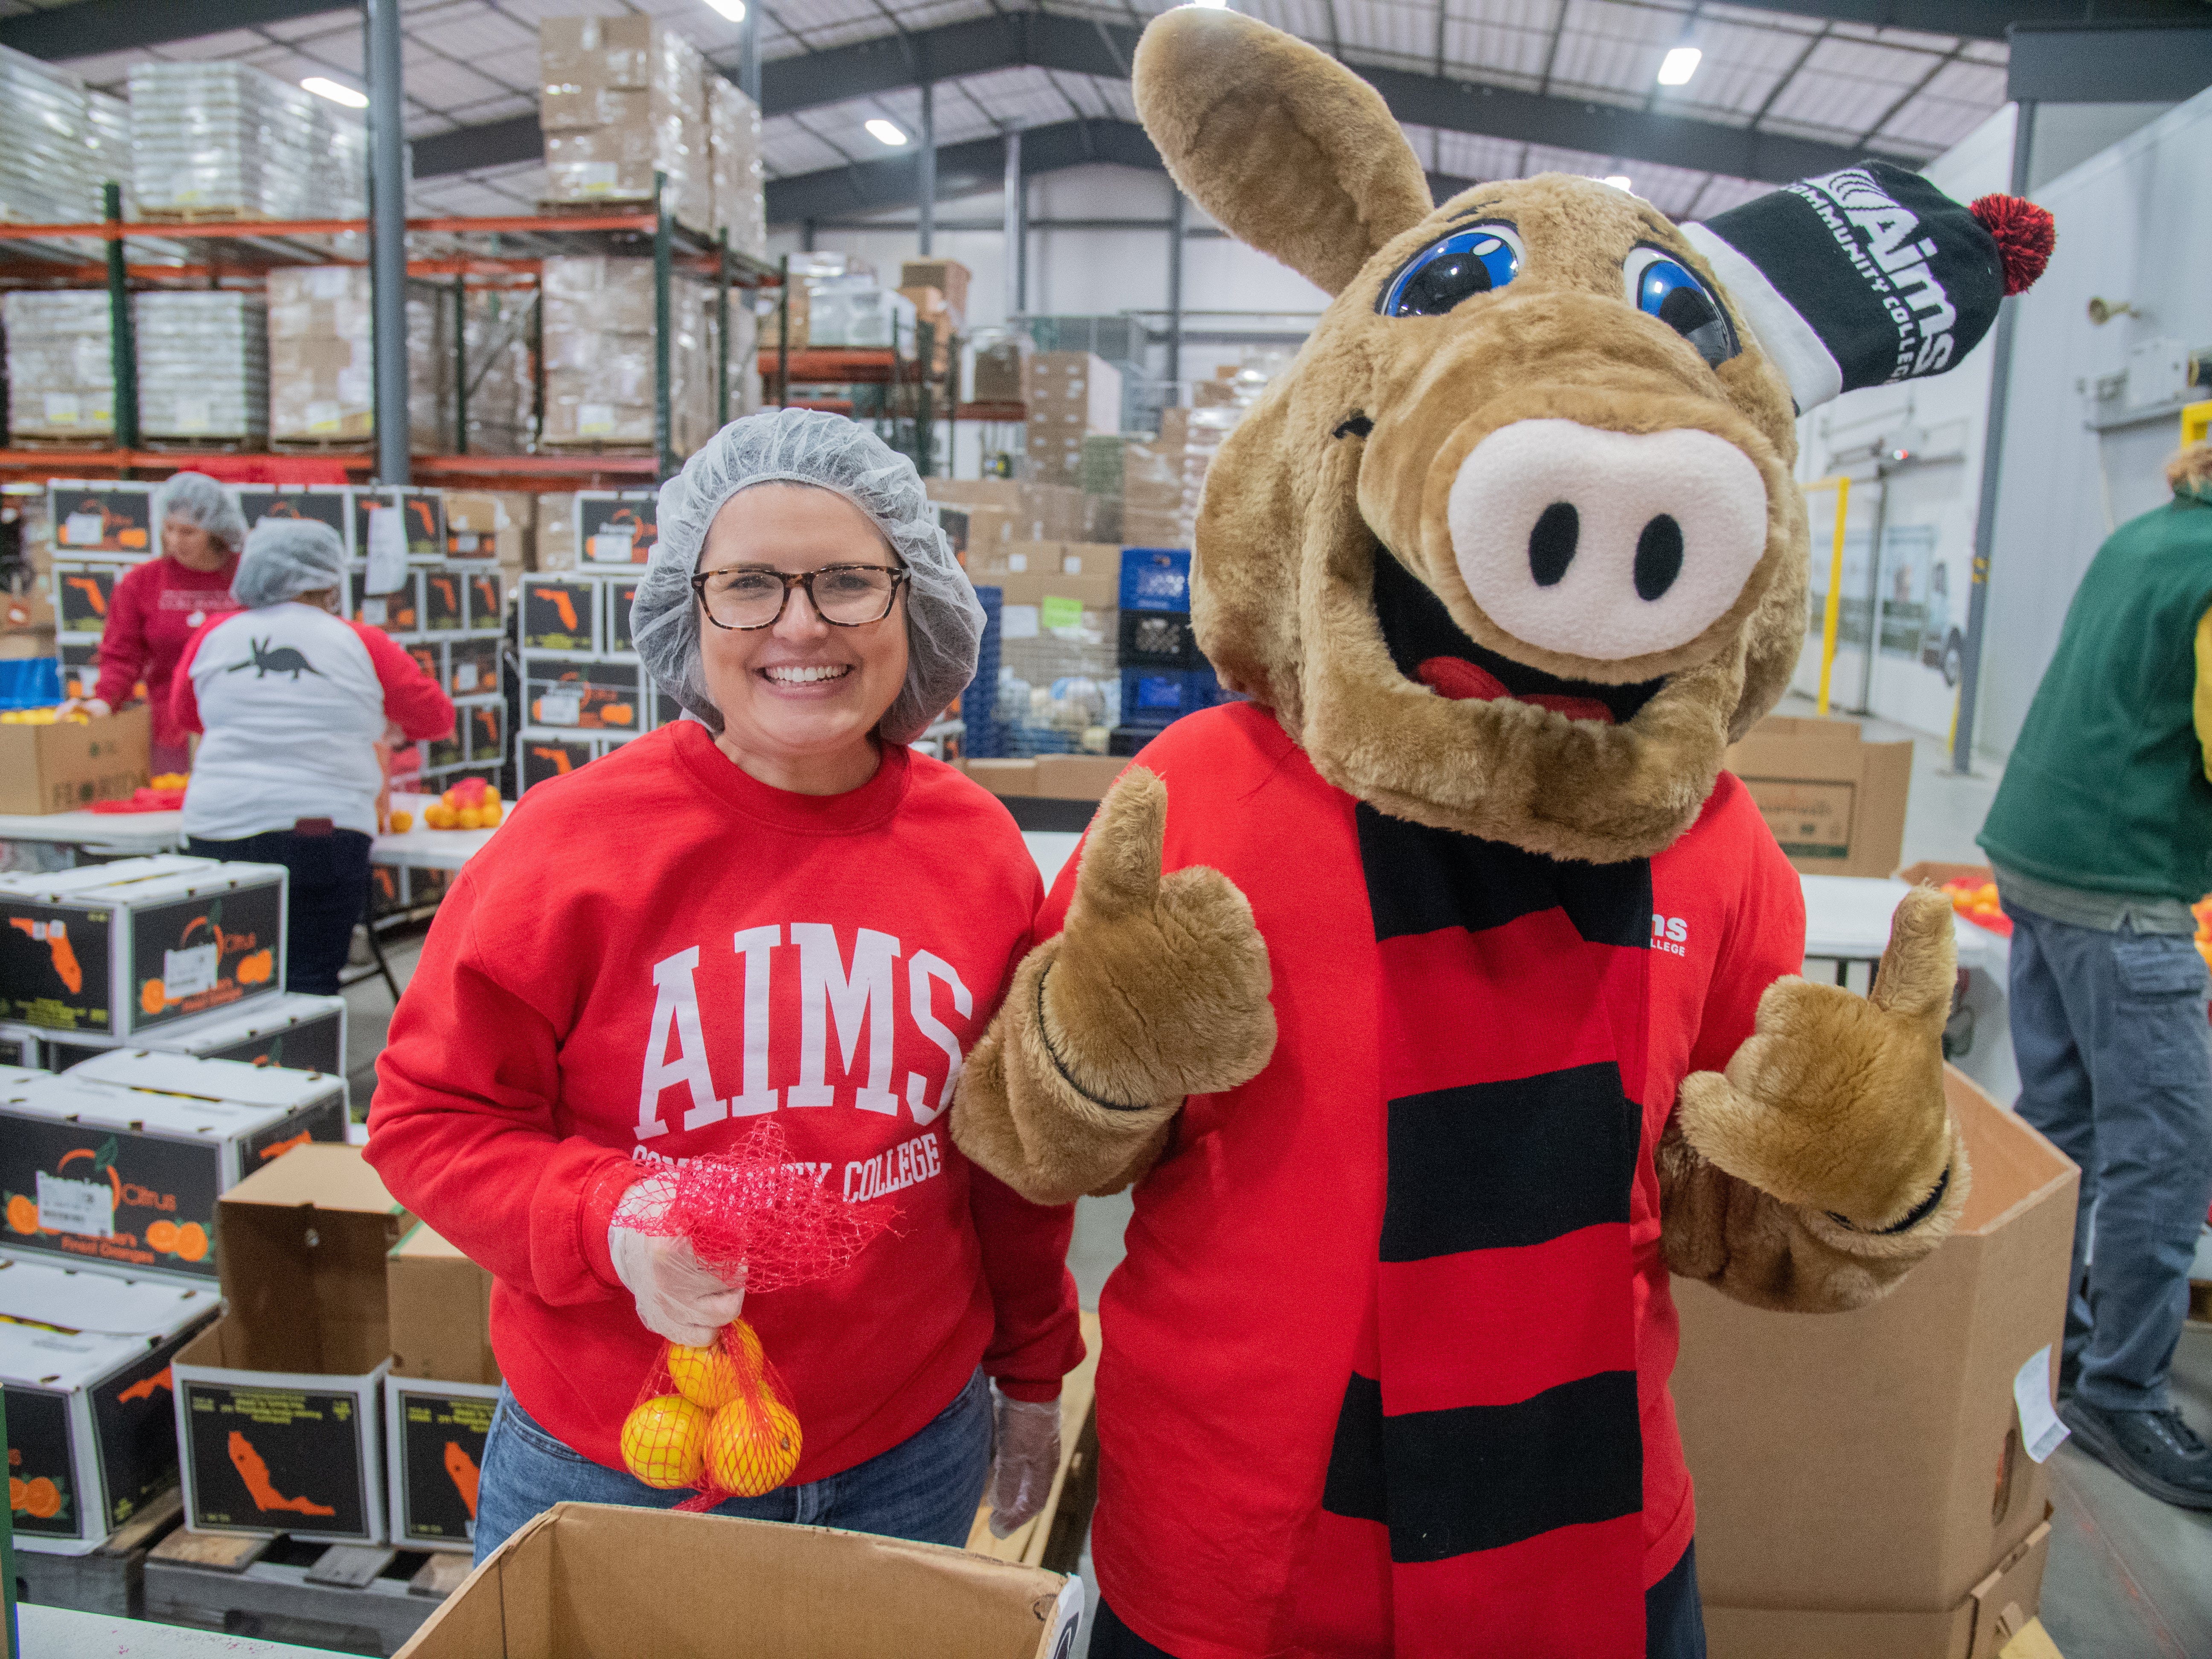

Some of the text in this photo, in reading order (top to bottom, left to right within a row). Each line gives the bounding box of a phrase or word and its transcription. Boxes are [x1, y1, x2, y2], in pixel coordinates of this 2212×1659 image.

[1843, 207, 1956, 375] Aims
[633, 923, 973, 1141] AIMS
[843, 1132, 940, 1203] COLLEGE
